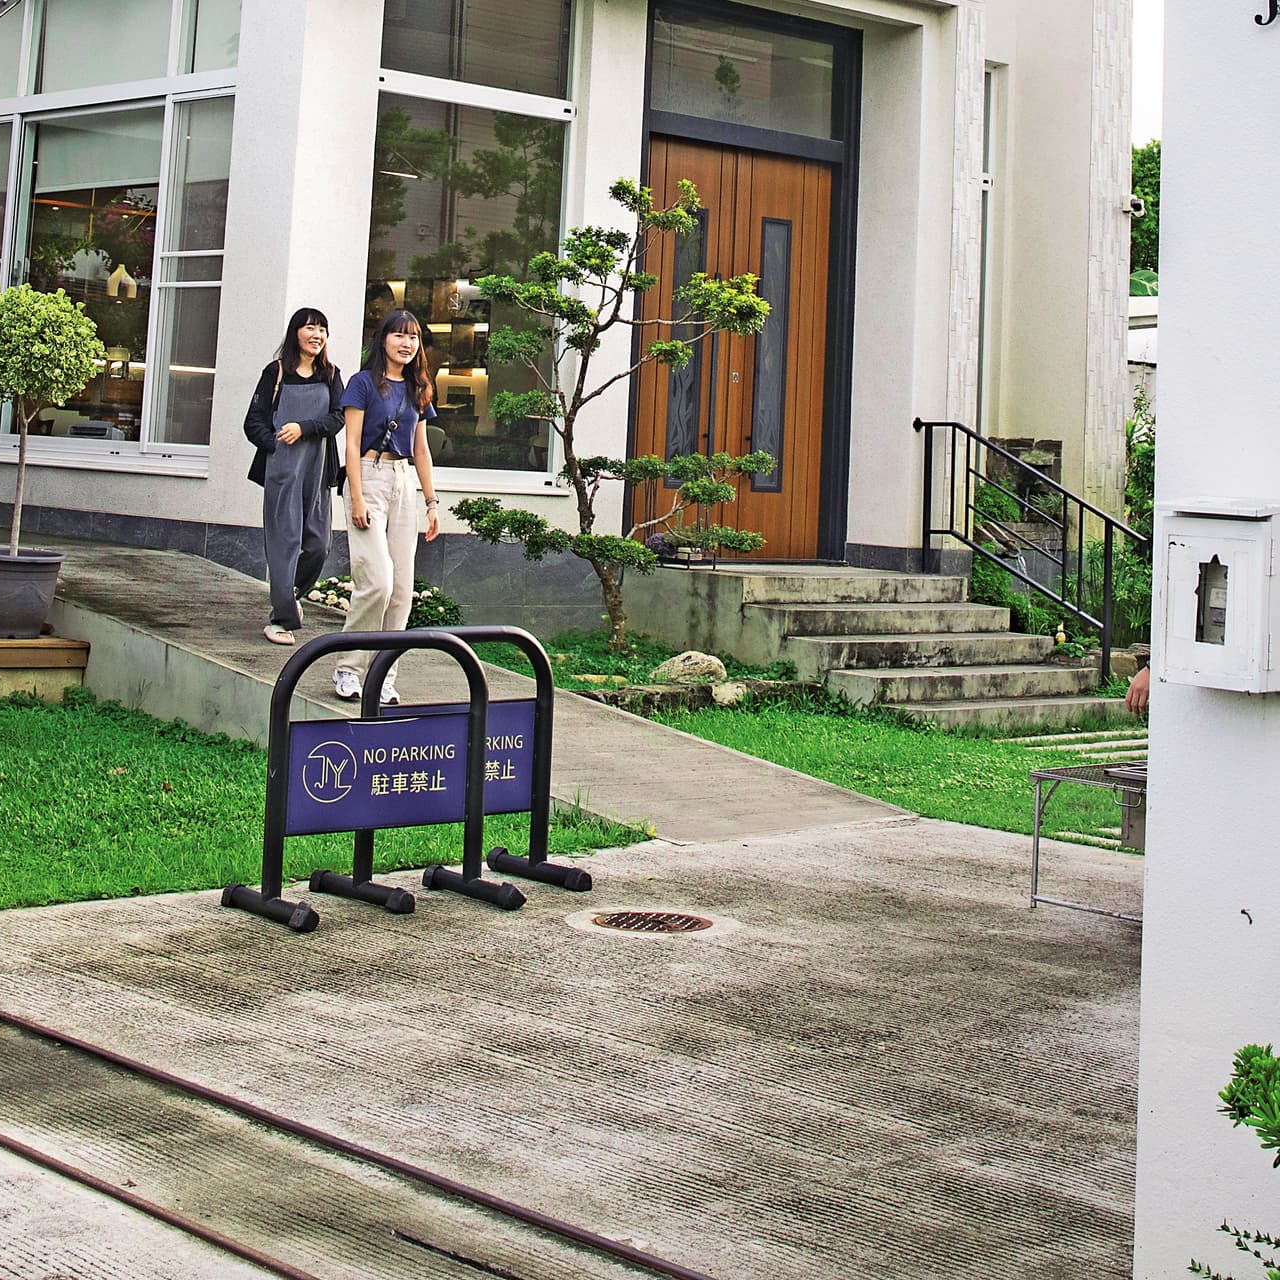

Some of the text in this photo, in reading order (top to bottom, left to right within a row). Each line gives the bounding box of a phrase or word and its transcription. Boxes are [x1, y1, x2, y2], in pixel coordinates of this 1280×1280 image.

[486, 734, 524, 751] RKING
[363, 744, 455, 764] NO PARKING
[485, 759, 516, 782] 禁止
[370, 769, 447, 796] 駐車禁止
